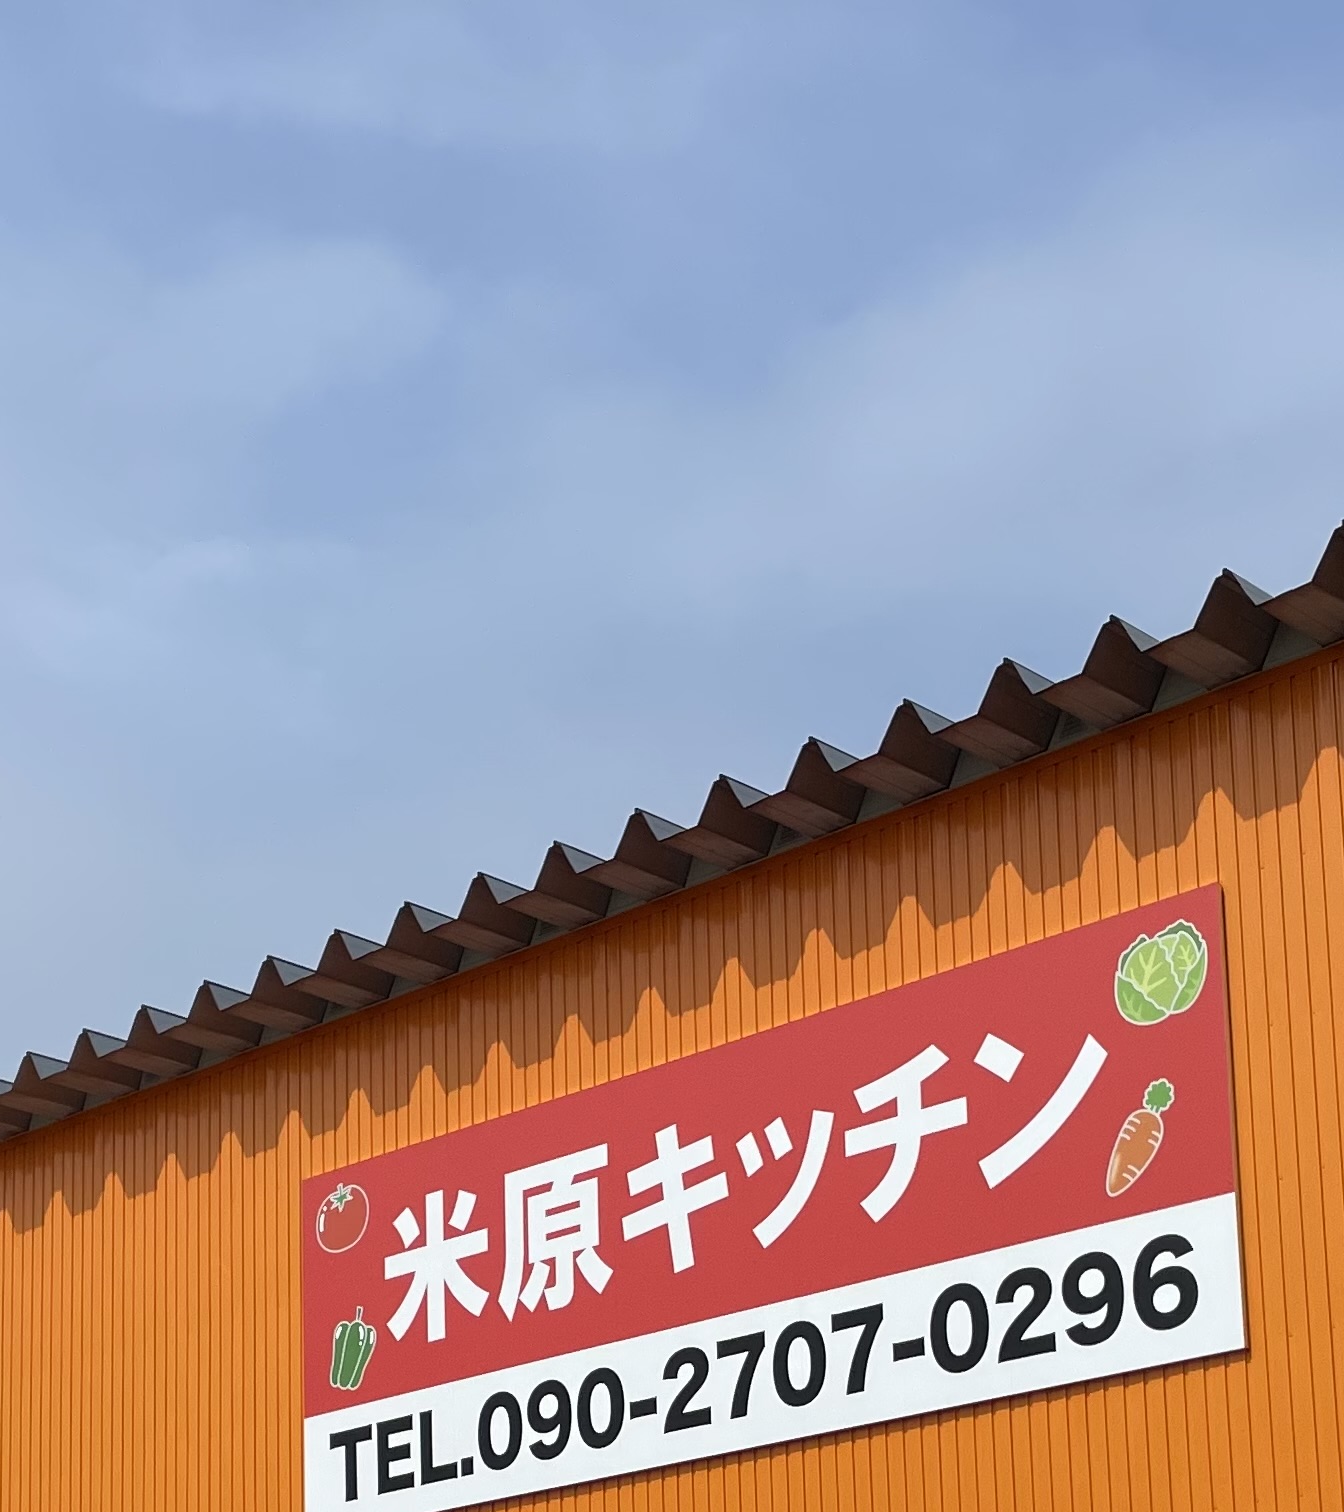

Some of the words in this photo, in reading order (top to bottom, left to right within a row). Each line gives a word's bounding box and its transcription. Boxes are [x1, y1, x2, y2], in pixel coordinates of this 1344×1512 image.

[383, 1032, 1108, 1343] 米原キッチン
[329, 1233, 1200, 1503] TEL.090-2707-0296
